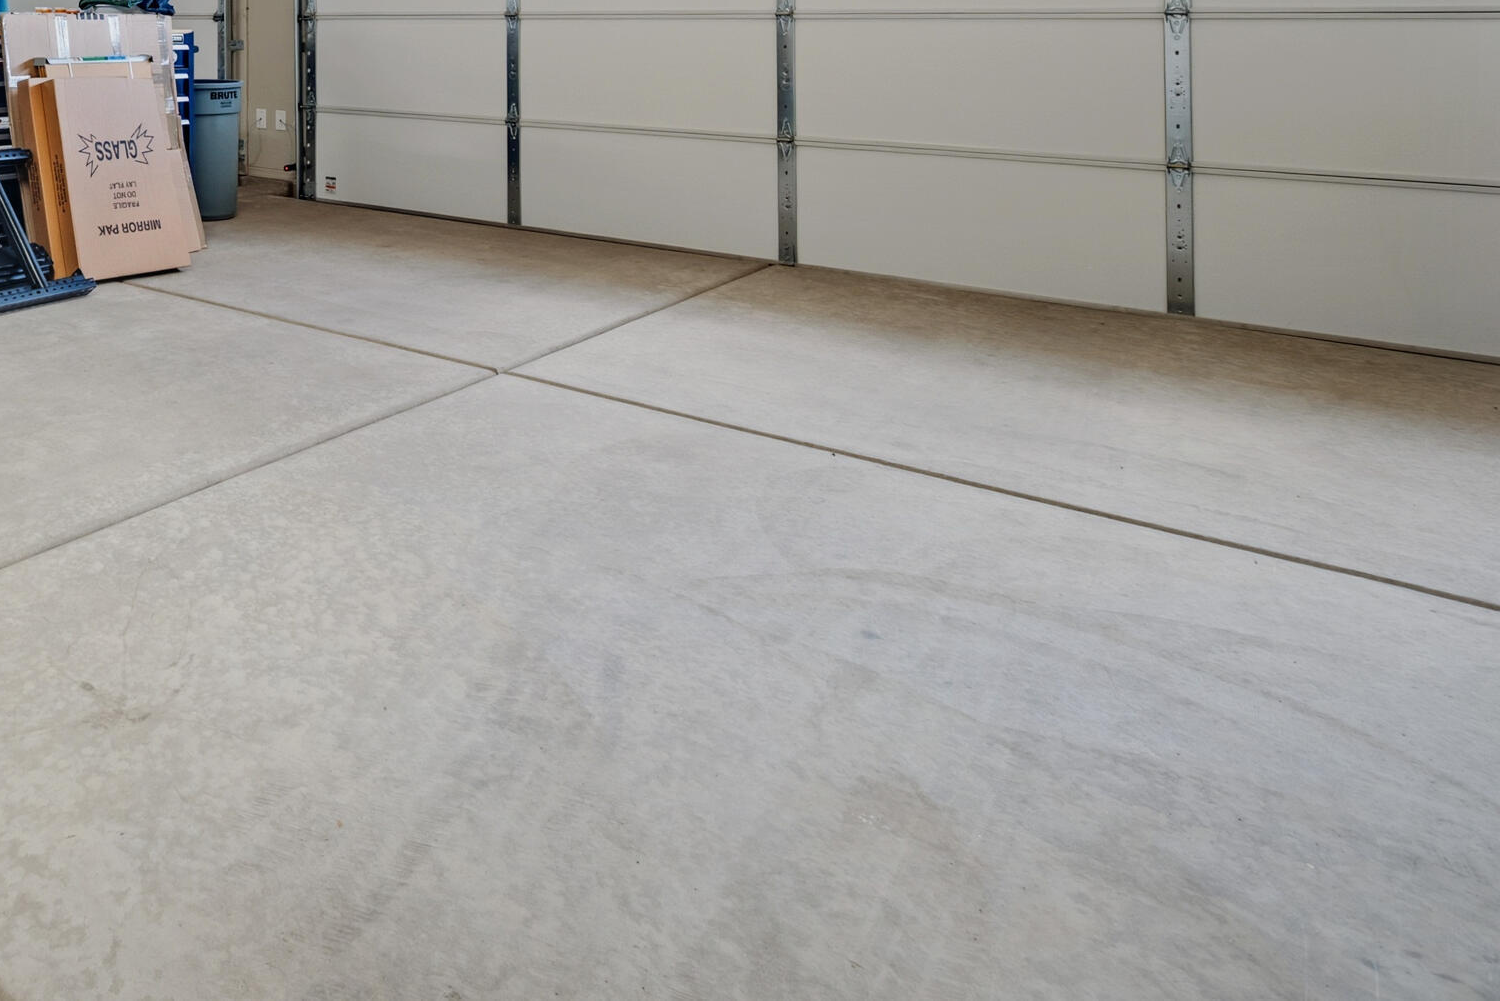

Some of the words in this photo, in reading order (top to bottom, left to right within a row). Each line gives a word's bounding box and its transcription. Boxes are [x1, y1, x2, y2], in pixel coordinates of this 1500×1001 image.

[209, 90, 238, 100] BRUTE
[94, 139, 138, 161] GLASS
[113, 191, 126, 200] NOT
[127, 190, 137, 198] DO
[112, 201, 140, 210] FRAGILE
[98, 224, 120, 237] PAK
[121, 219, 162, 234] MIRROR
